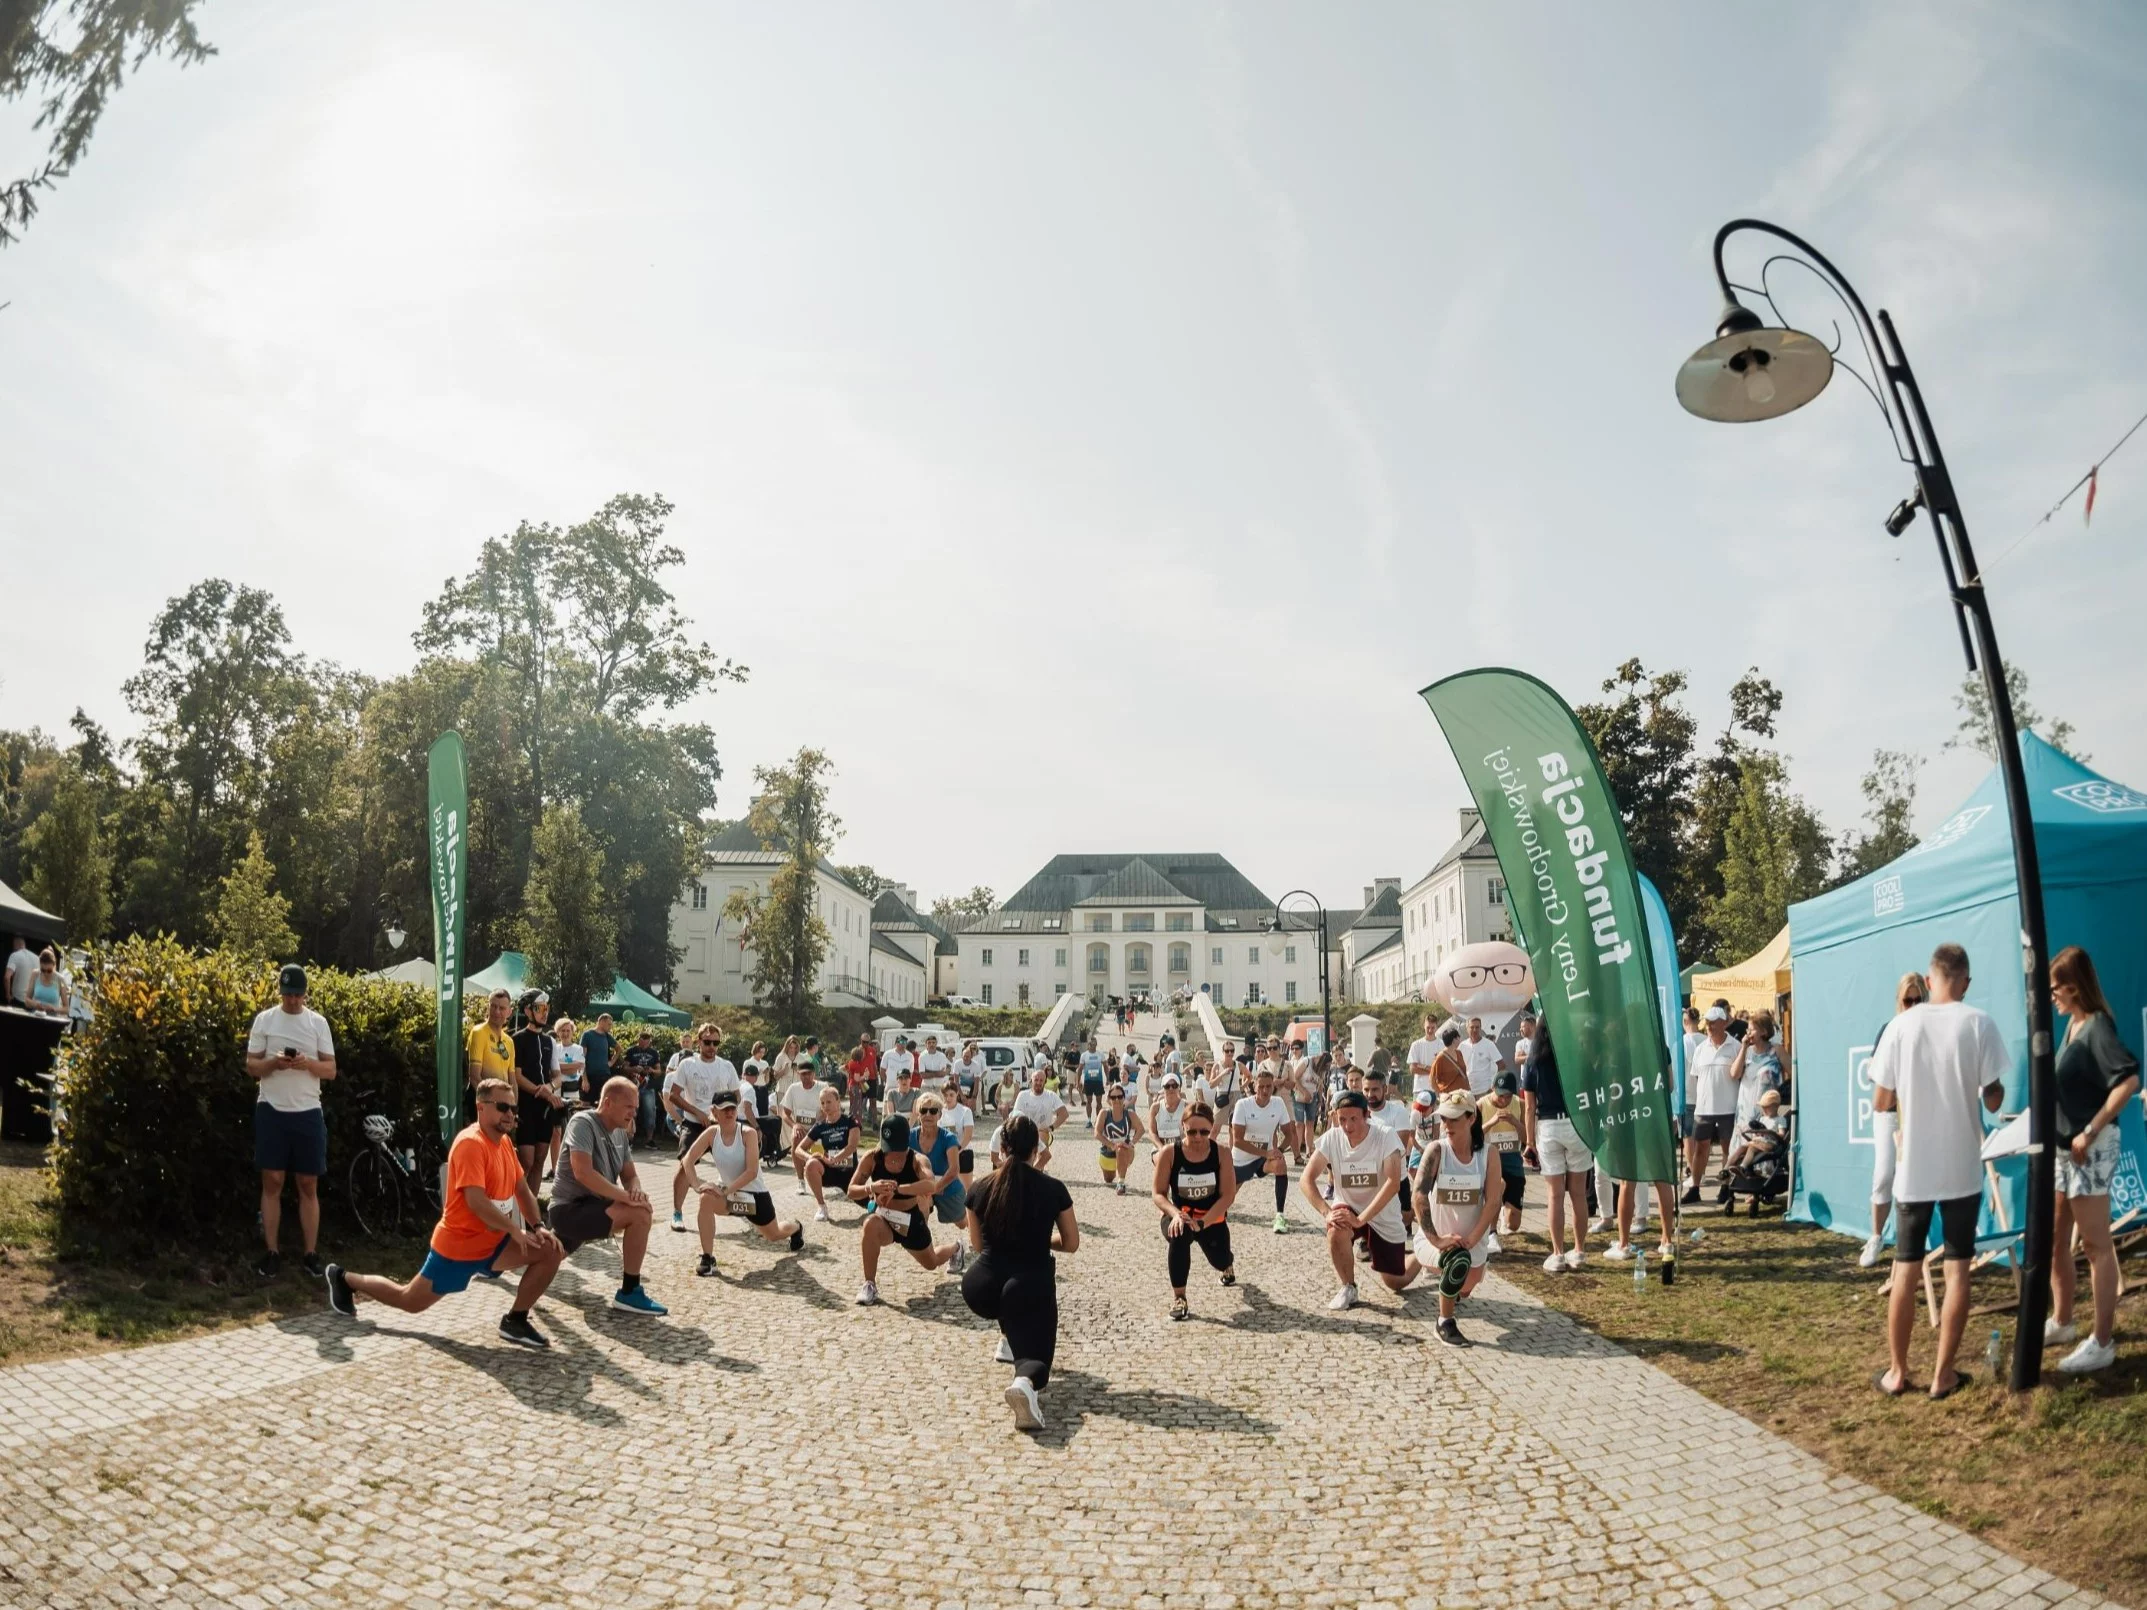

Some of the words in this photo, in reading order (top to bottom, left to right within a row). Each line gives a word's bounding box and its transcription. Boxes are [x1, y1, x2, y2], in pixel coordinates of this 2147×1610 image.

[1876, 880, 1898, 897] COOL
[1877, 895, 1893, 911] PRO
[1498, 1142, 1513, 1150] 100
[1350, 1175, 1369, 1186] 112
[1187, 1187, 1208, 1197] 103
[1447, 1191, 1470, 1202] 115
[733, 1203, 749, 1212] 031
